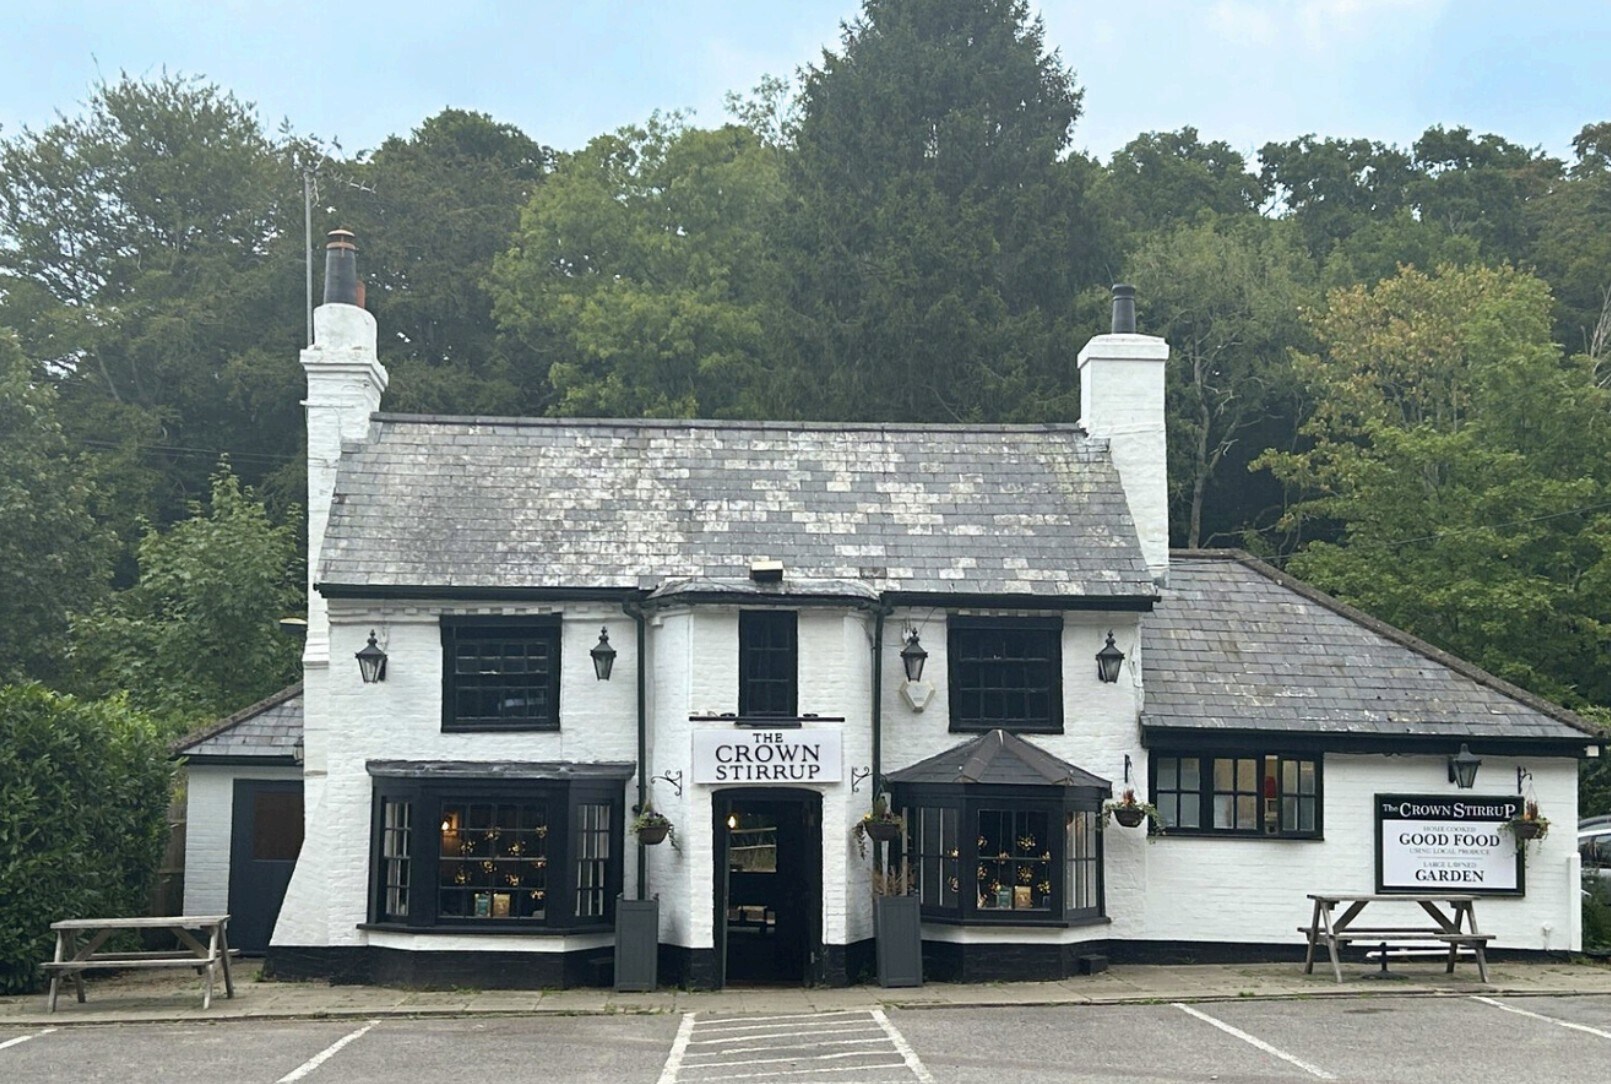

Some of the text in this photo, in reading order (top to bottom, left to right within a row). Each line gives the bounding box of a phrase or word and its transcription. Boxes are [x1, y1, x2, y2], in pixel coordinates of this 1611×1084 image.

[753, 732, 784, 743] THE
[715, 744, 821, 763] CROWN
[715, 764, 821, 780] STIRRUP
[1382, 802, 1516, 819] The CROWN STIRRUP
[1399, 833, 1500, 847] GOOD FOOD
[1458, 848, 1490, 856] PRODUCE
[1415, 869, 1484, 882] GARDEN
